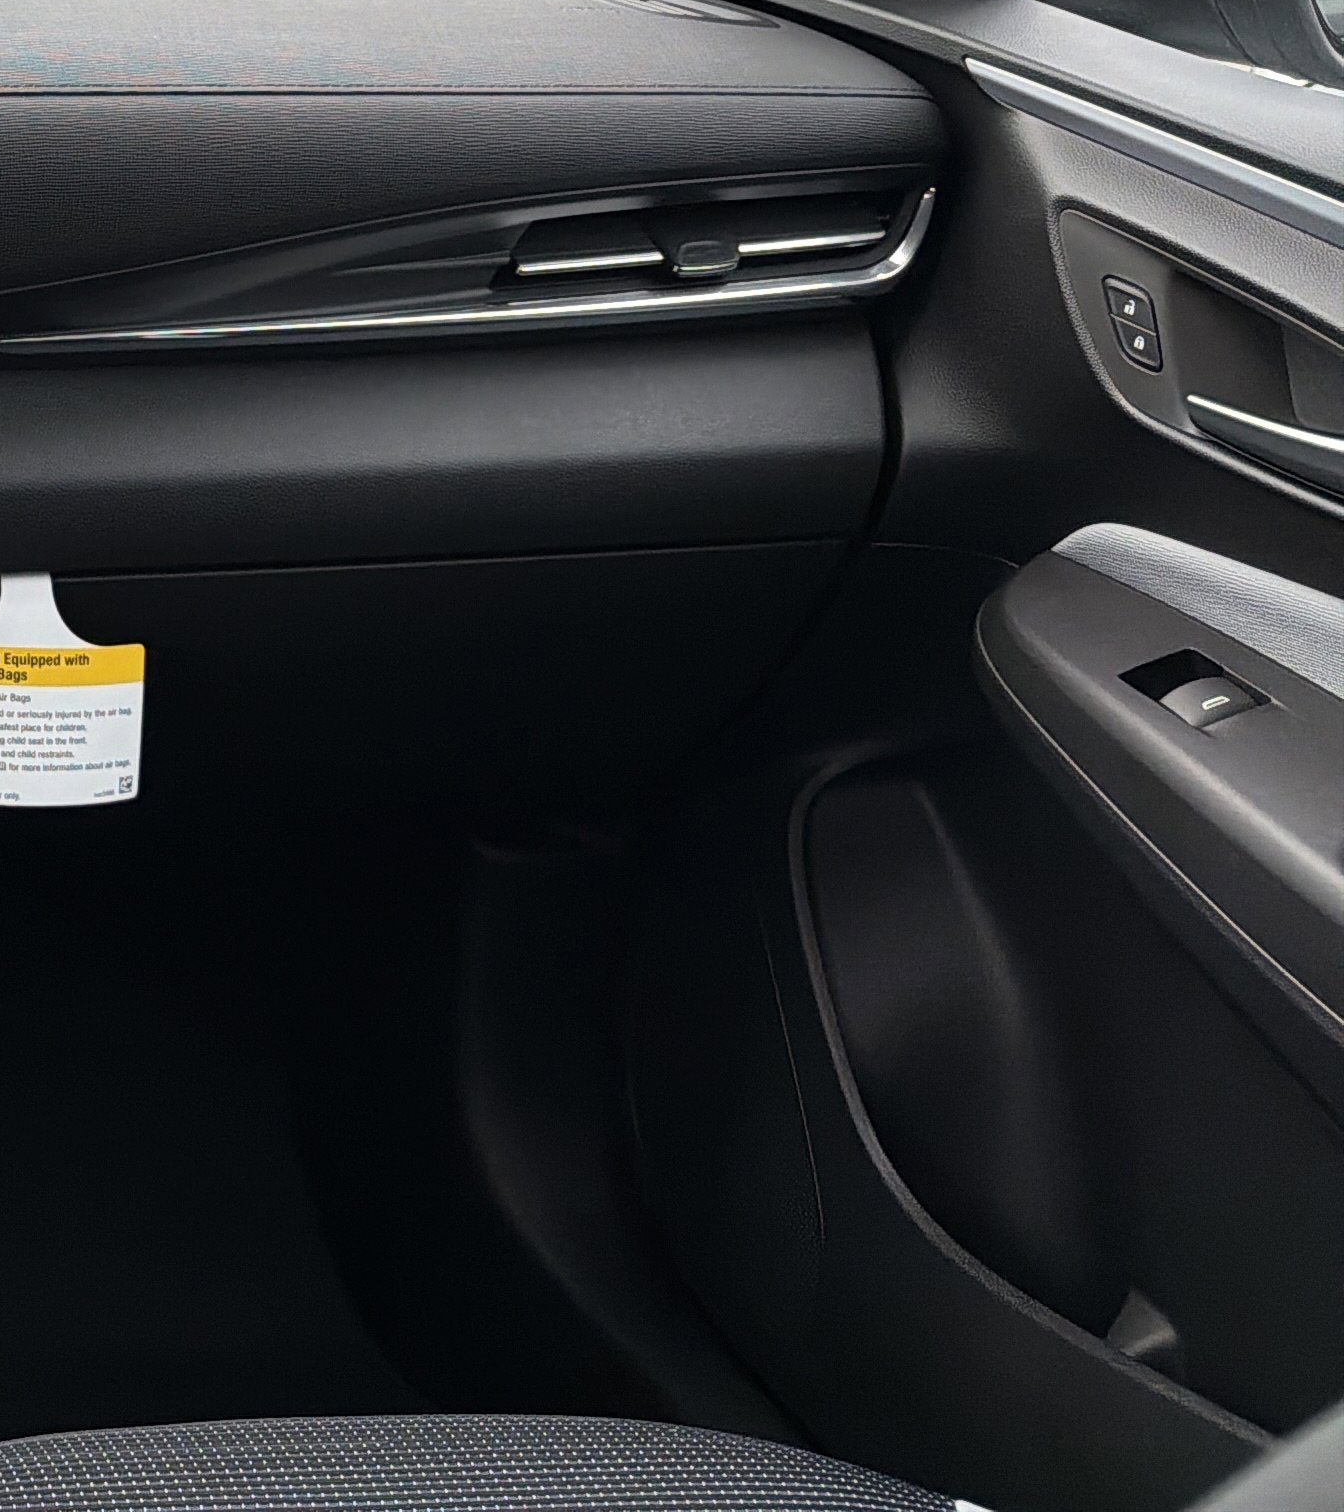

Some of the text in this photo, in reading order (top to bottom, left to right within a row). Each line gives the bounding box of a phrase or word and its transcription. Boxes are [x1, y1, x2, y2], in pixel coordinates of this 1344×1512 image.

[3, 652, 61, 668] Equipped
[63, 652, 90, 666] with
[9, 692, 32, 704] Bags
